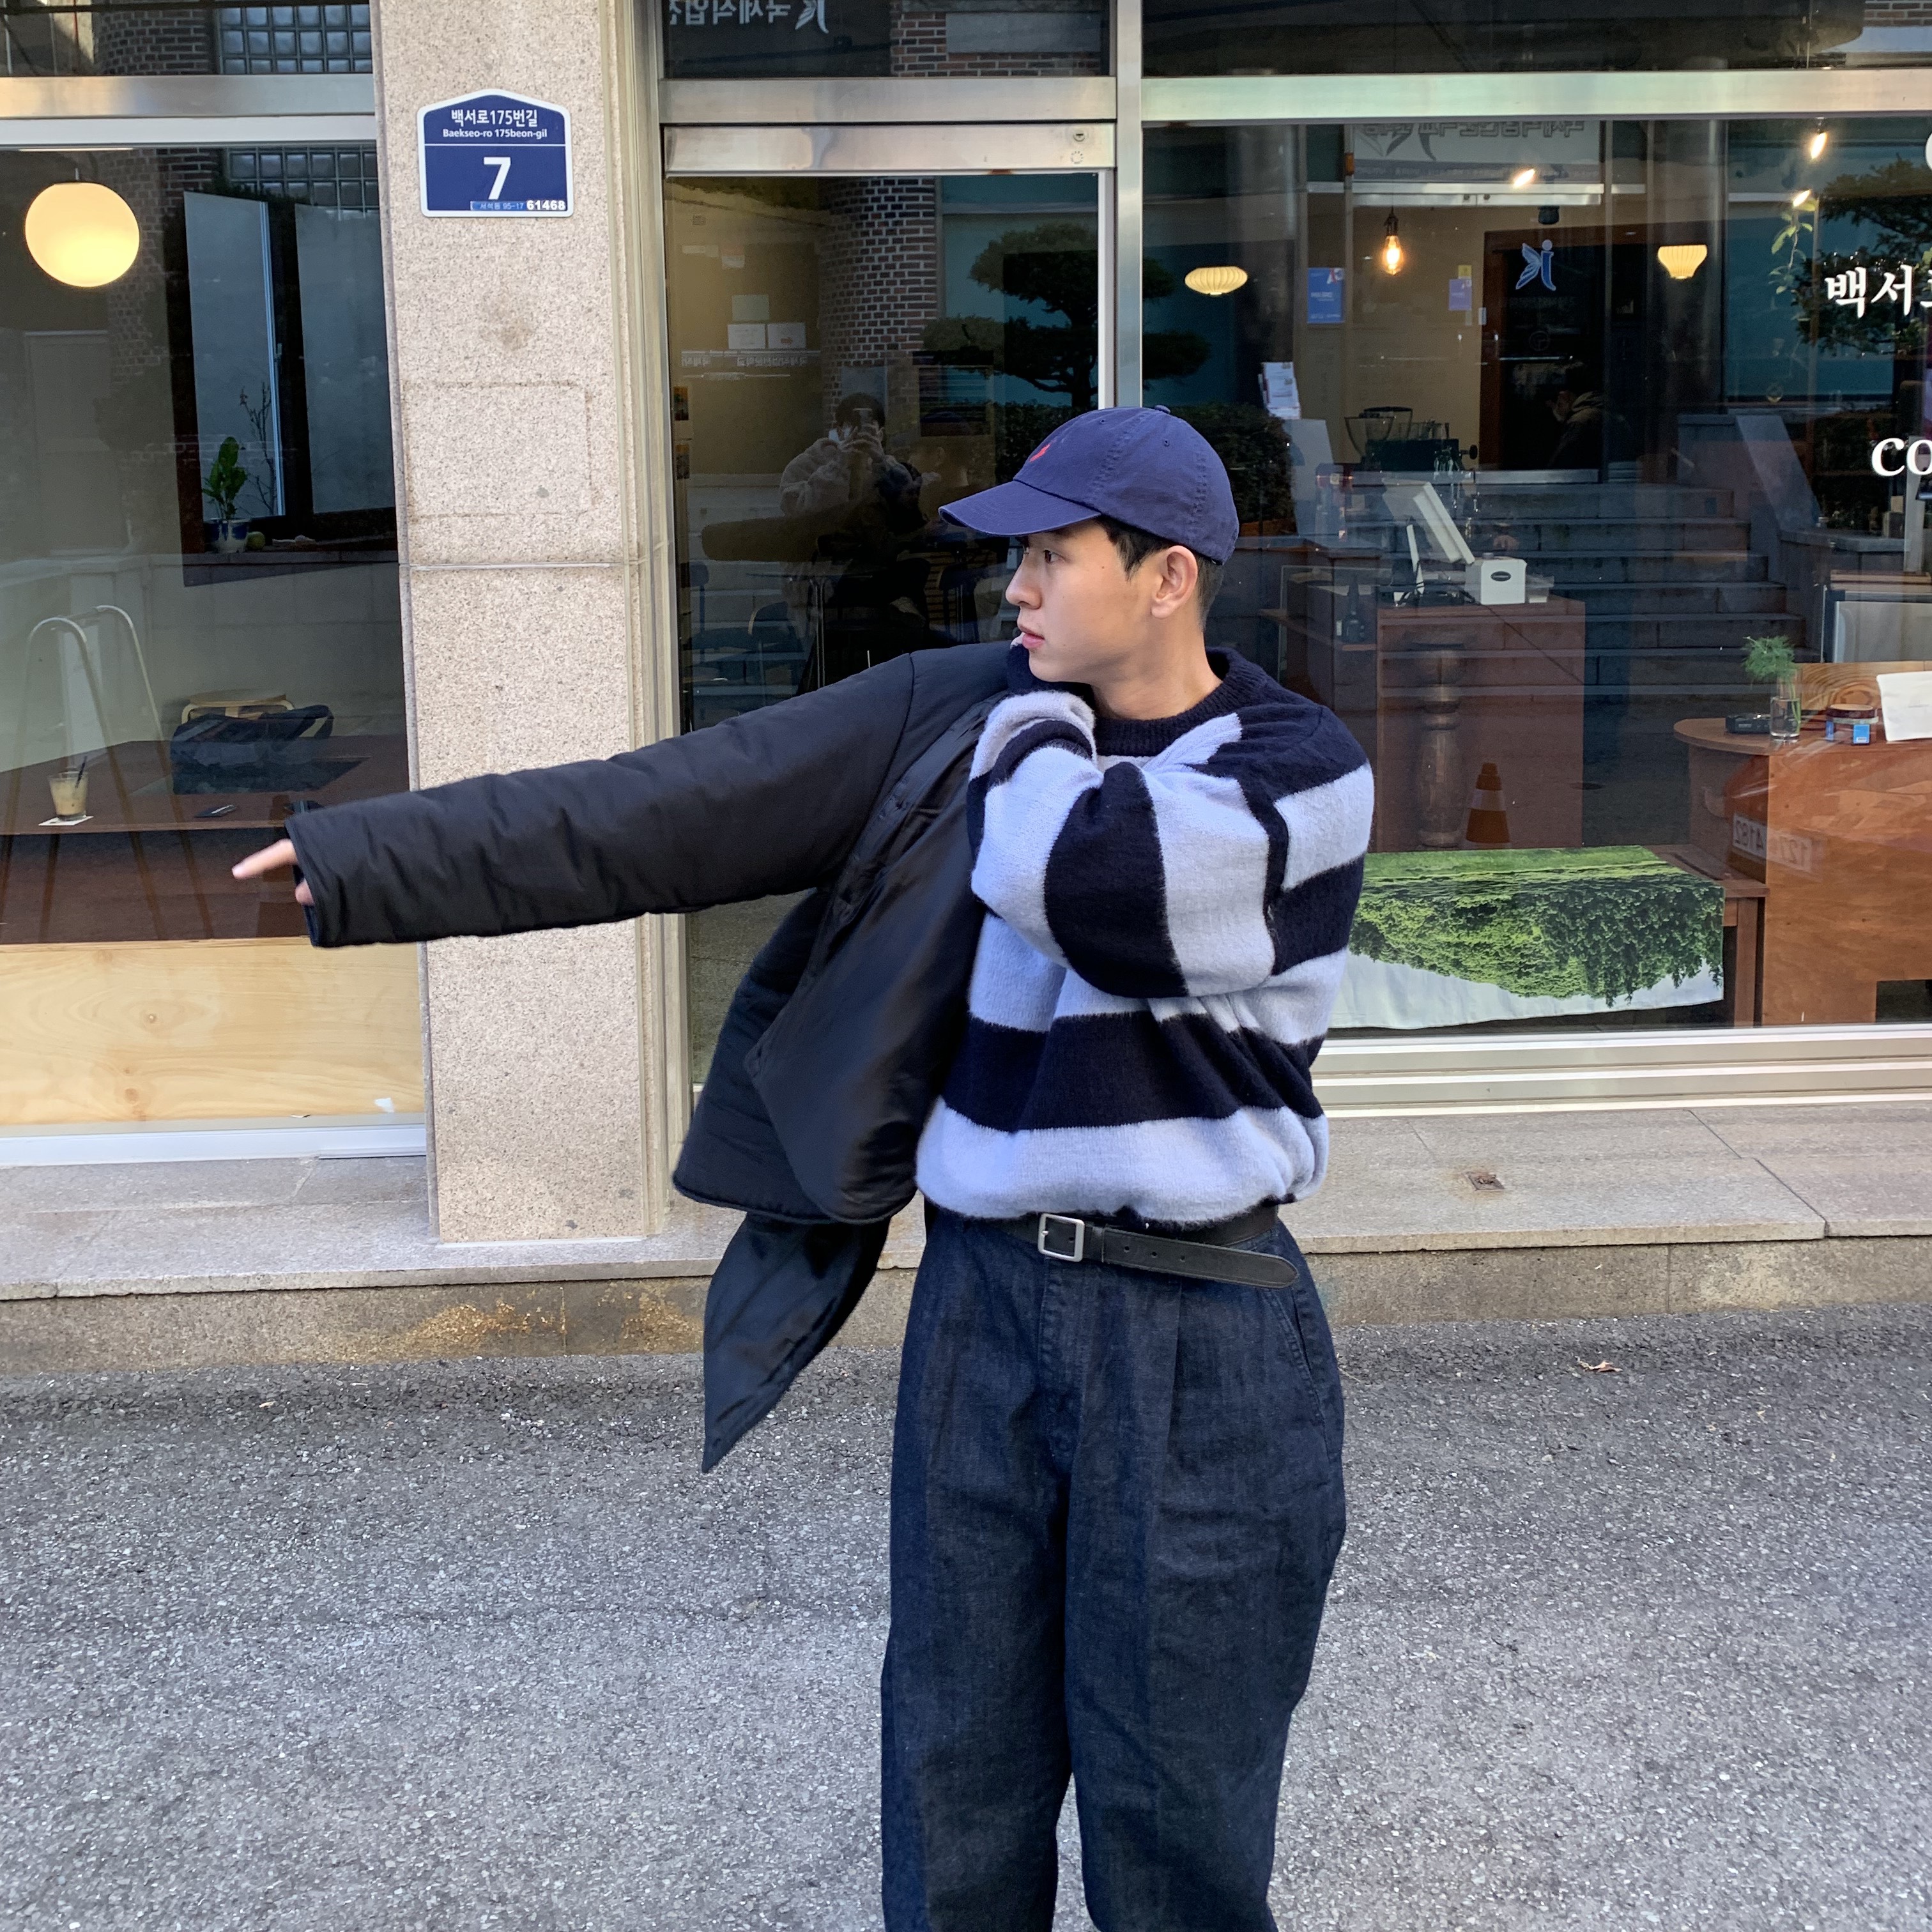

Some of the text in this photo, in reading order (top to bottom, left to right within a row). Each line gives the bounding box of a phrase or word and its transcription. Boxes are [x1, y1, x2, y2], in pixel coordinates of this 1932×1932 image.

[451, 109, 538, 127] 백서로175번길
[443, 128, 548, 139] Baekseo-ro 175beon-gil
[484, 157, 511, 200] 7
[526, 200, 566, 210] 61468
